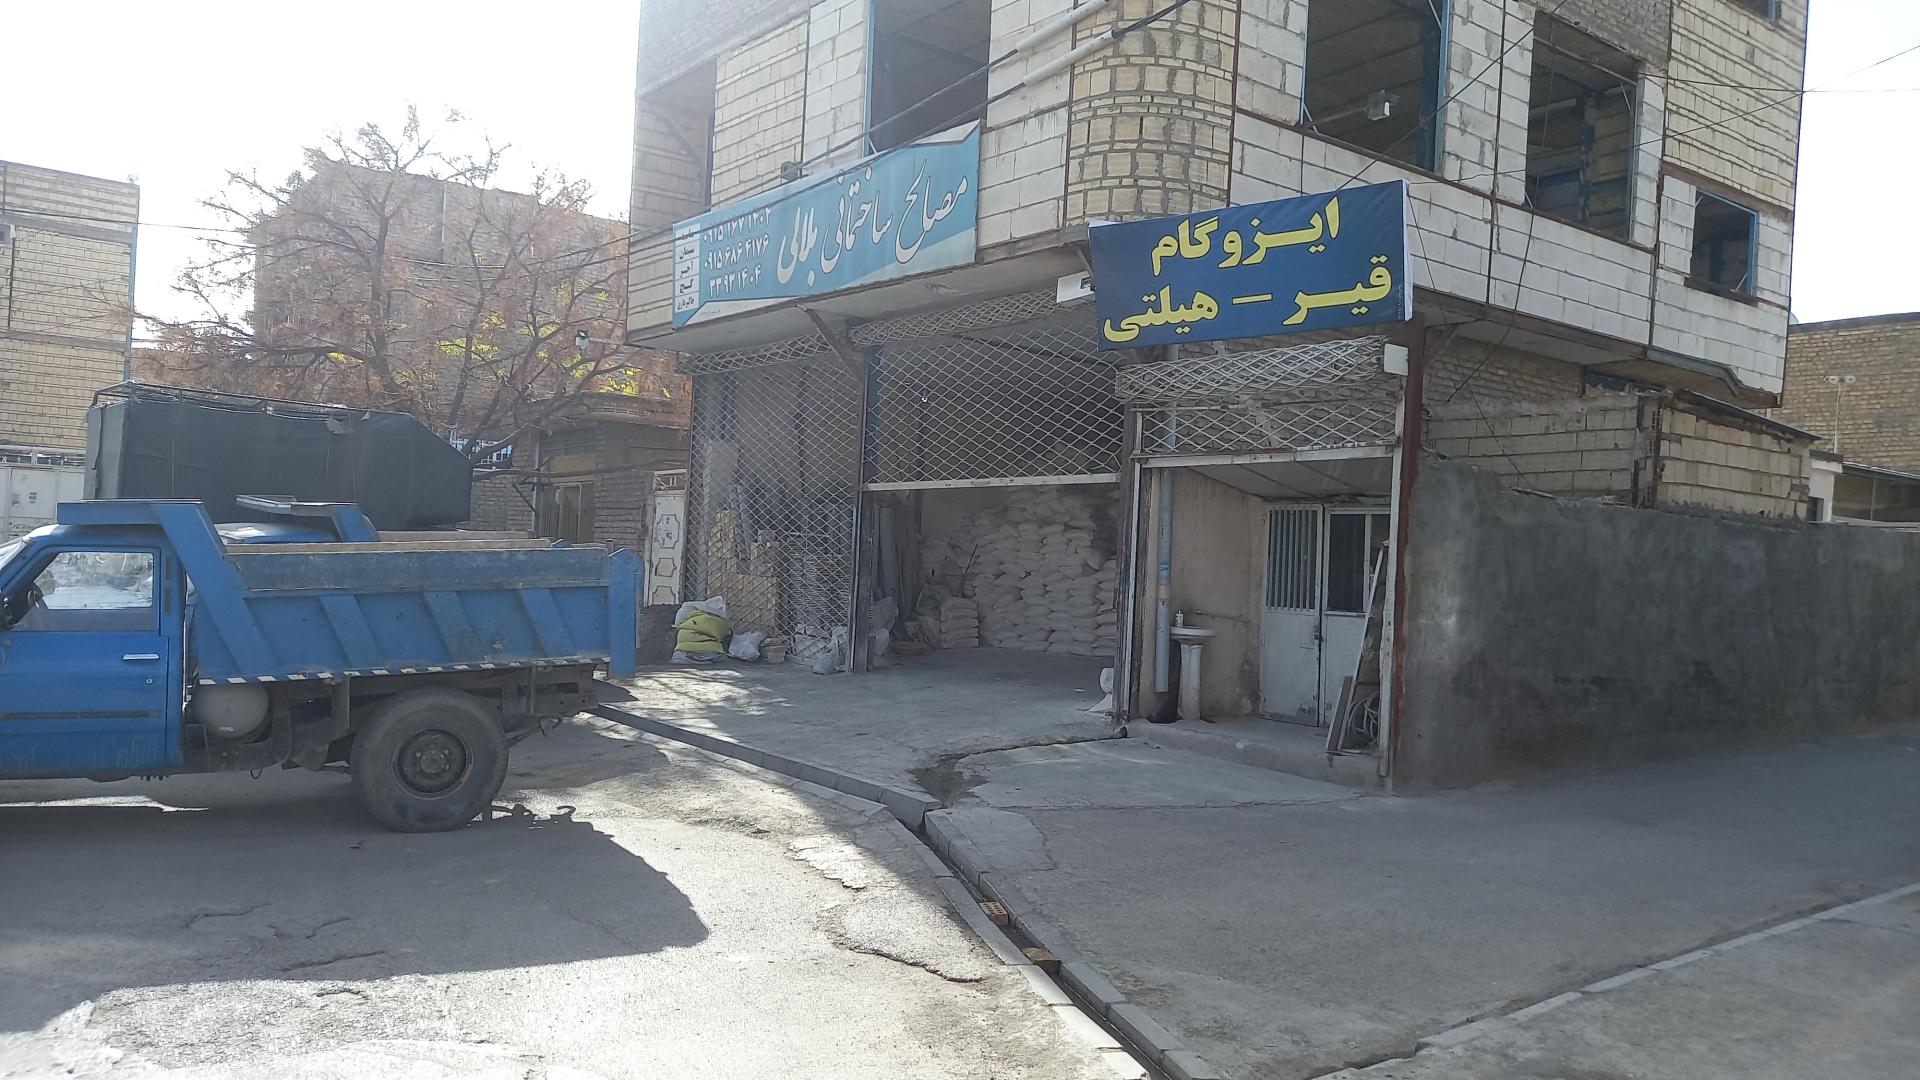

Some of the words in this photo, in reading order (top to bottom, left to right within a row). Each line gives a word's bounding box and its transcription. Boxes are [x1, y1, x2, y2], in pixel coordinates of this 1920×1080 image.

[821, 166, 893, 275] ساختمانی
[895, 159, 968, 264] مصالح
[1150, 196, 1340, 277] ایزوگام
[1103, 285, 1220, 342] هیلتی
[1282, 255, 1393, 326] قیر
